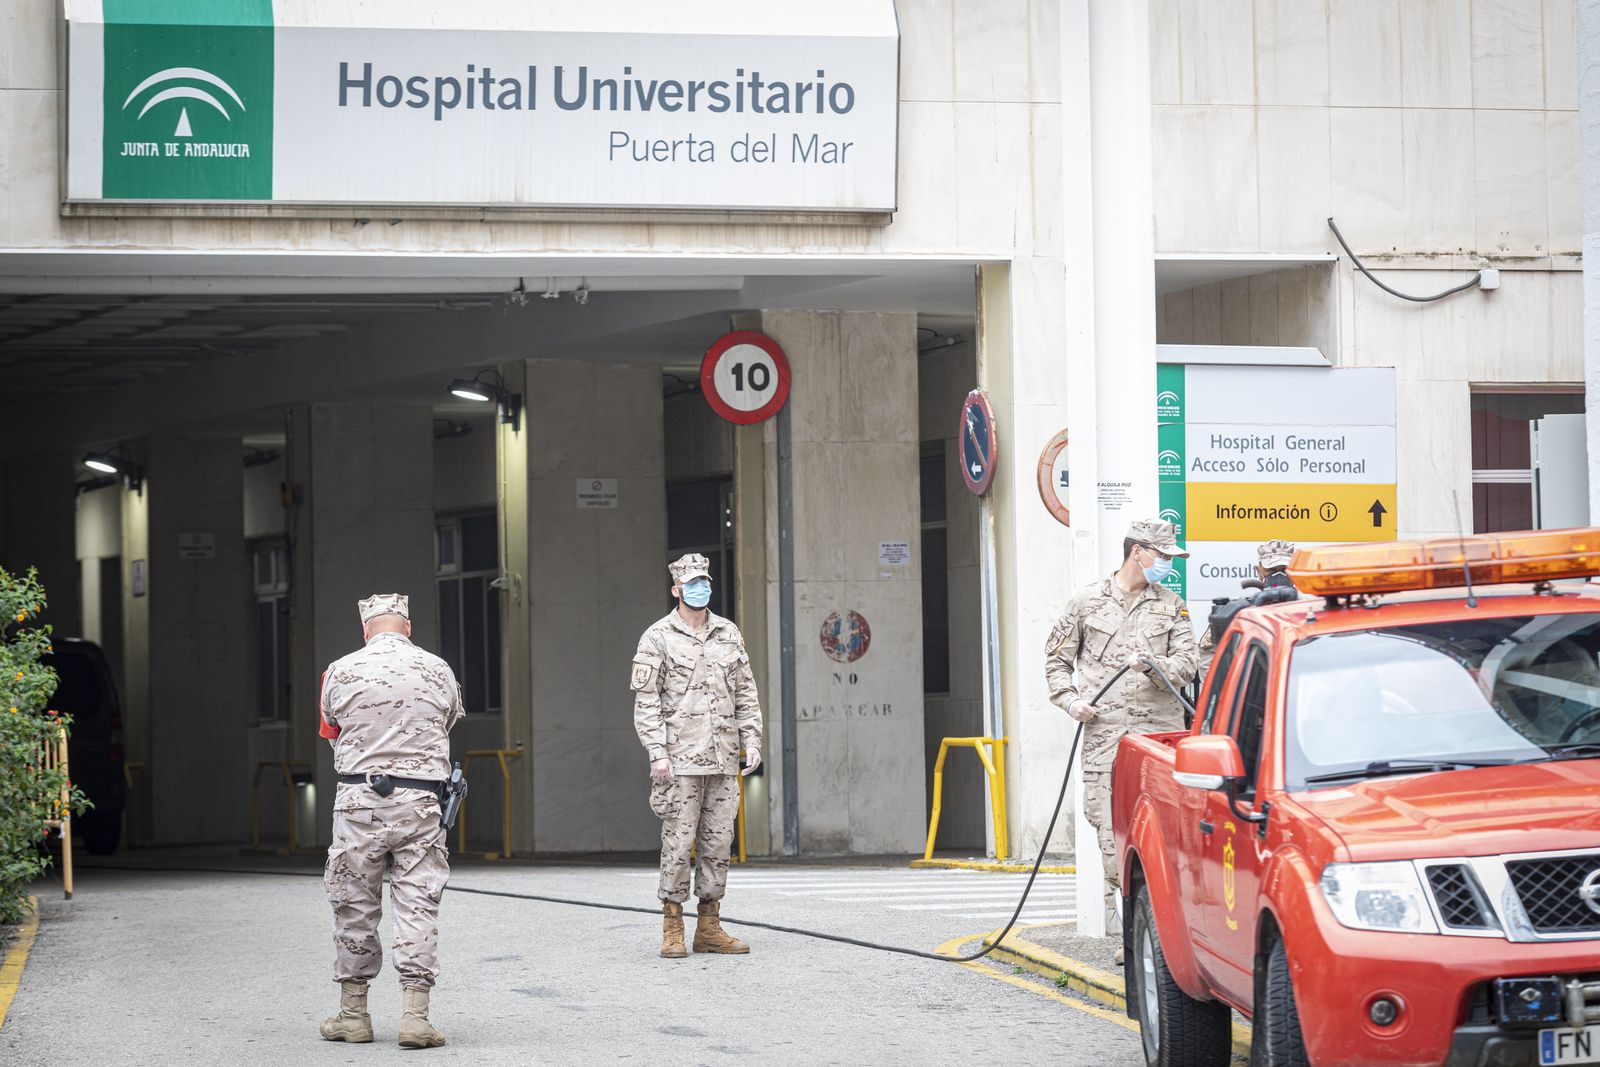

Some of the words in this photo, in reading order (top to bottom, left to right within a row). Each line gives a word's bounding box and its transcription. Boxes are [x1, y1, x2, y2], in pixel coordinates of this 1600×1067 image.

[338, 62, 537, 121] Hospital
[553, 66, 856, 115] Universitario
[120, 142, 160, 157] JUNTA
[164, 142, 180, 157] DE
[184, 142, 251, 158] ANDALUCIA
[609, 131, 716, 163] Puerta
[730, 132, 776, 163] del
[791, 133, 854, 164] Mar
[731, 362, 771, 392] 10
[1210, 434, 1275, 453] Hospital
[1285, 434, 1346, 451] General
[1191, 457, 1246, 472] Acceso
[1256, 457, 1290, 473] Sólo
[1299, 458, 1366, 474] Personal
[1216, 503, 1311, 520] Información
[1200, 563, 1258, 578] Consult
[832, 672, 859, 686] NO
[1558, 1031, 1592, 1059] FN
